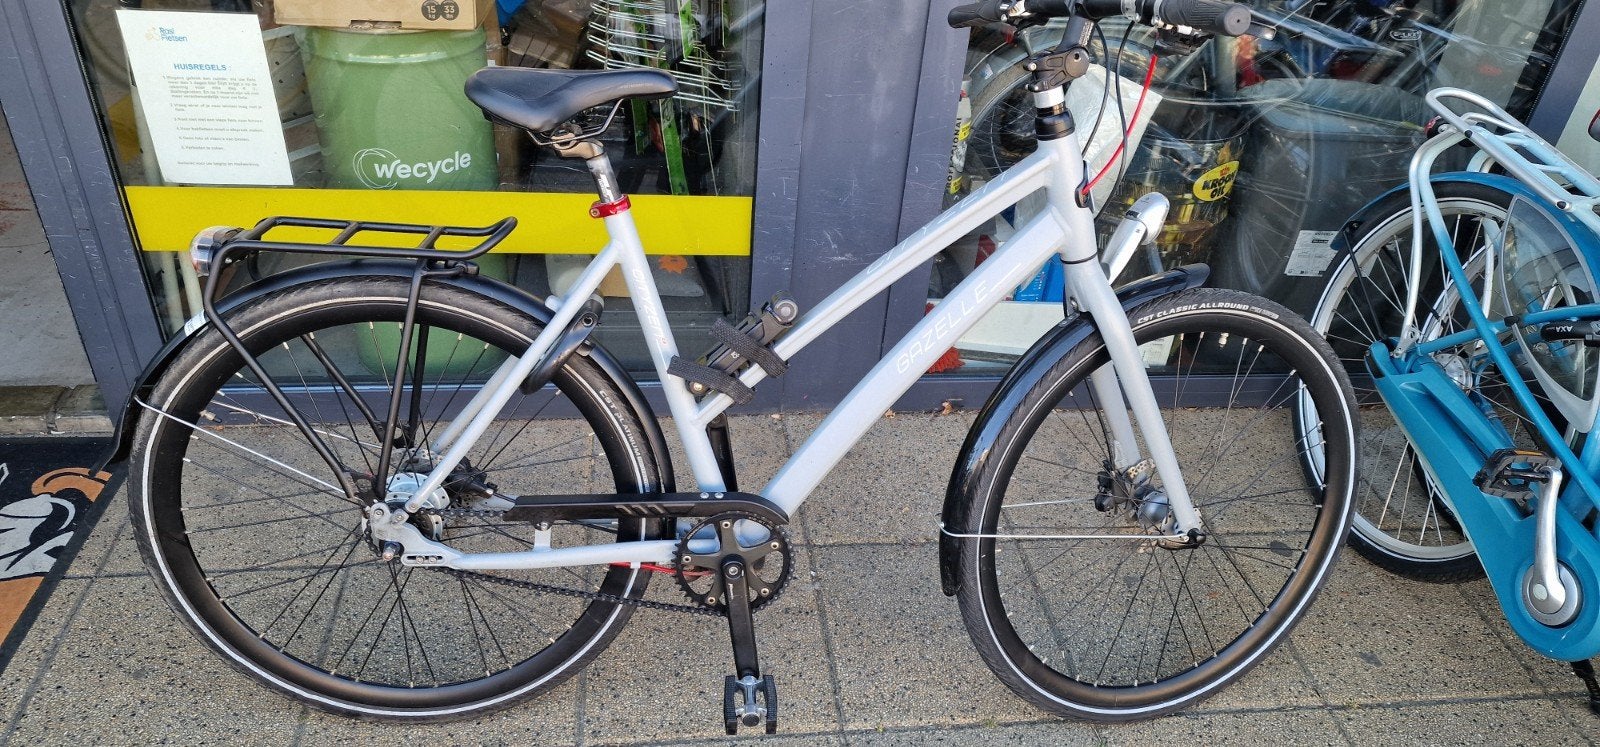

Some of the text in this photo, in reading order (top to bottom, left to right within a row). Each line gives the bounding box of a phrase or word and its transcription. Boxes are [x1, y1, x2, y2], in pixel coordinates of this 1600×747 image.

[427, 5, 436, 13] 15
[444, 5, 455, 13] 33
[174, 63, 227, 71] HUISREGELS
[374, 151, 472, 184] wecycle
[1210, 187, 1225, 199] OIL
[1137, 302, 1250, 325] CST CLASSIC ALLROUND
[896, 279, 990, 374] GAZELLE
[1555, 325, 1573, 333] AXA
[599, 390, 641, 456] CST PLATINUM
